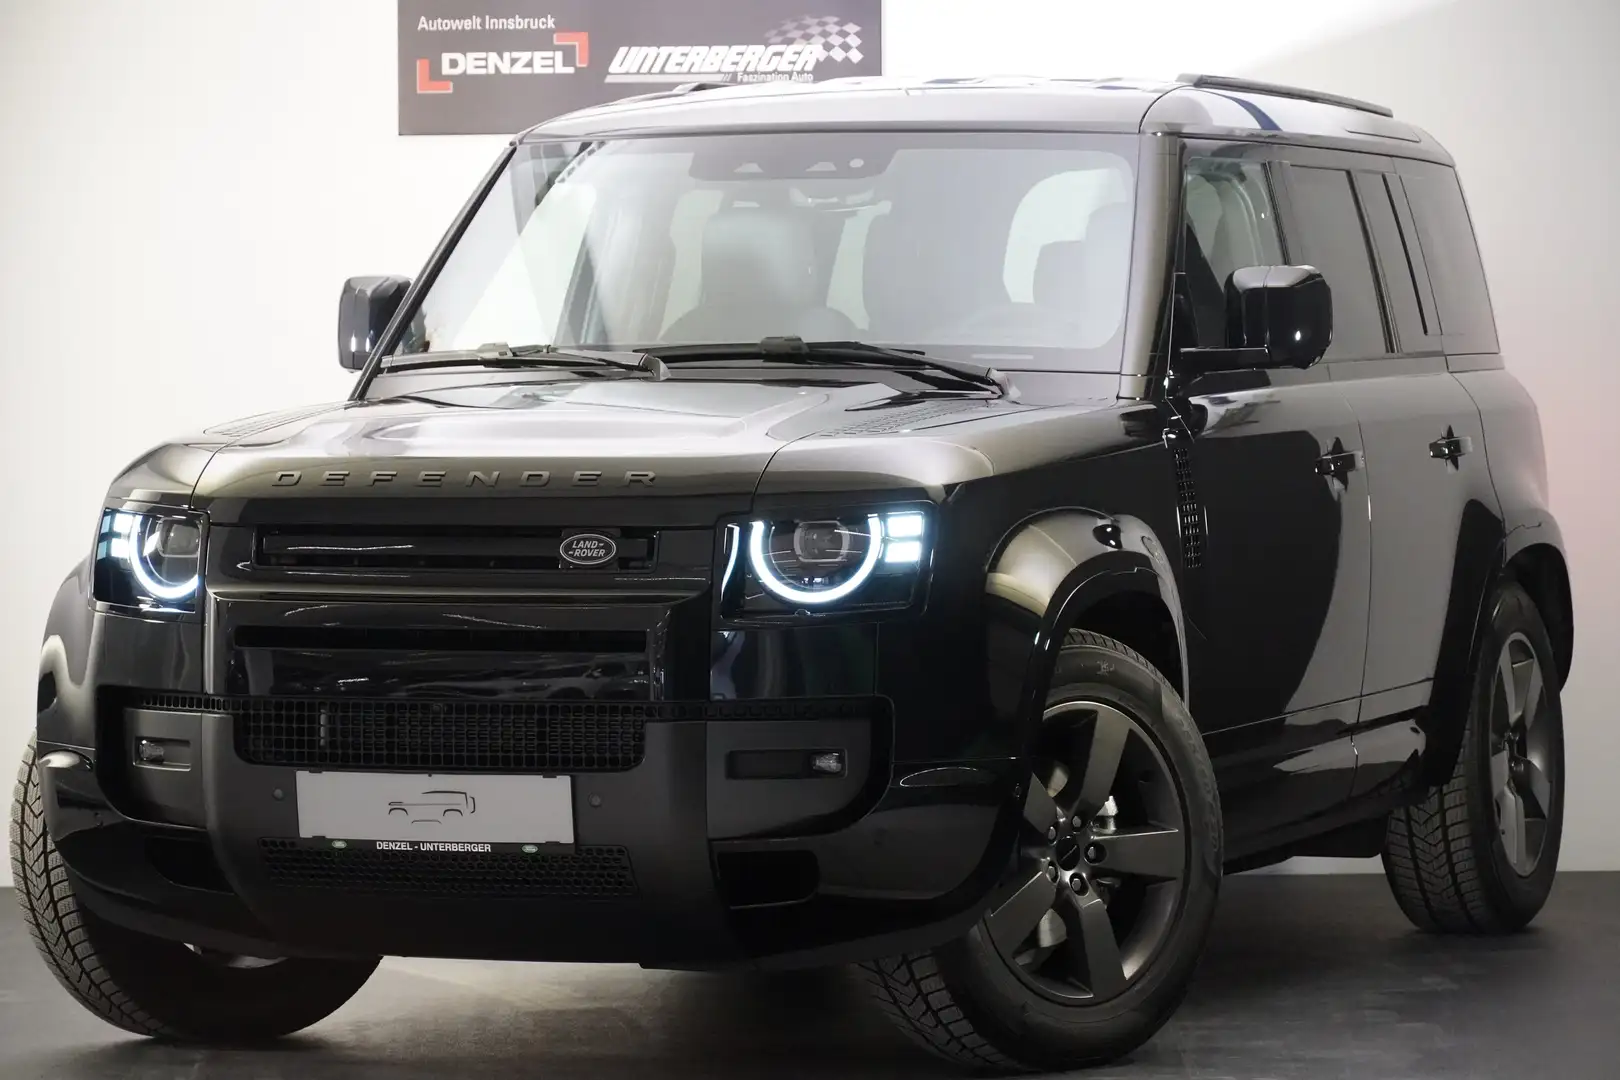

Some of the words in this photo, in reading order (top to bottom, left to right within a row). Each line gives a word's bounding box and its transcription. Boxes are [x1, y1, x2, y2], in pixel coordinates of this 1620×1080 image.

[417, 15, 482, 32] Autowelt
[485, 14, 556, 30] Innsbruck
[441, 50, 576, 76] DENZEL
[607, 44, 823, 74] UNTERBERGER
[790, 71, 814, 83] Auto
[271, 470, 657, 488] DEFENDER
[376, 841, 413, 851] DENZEL
[419, 842, 491, 853] UNTERBERGER
